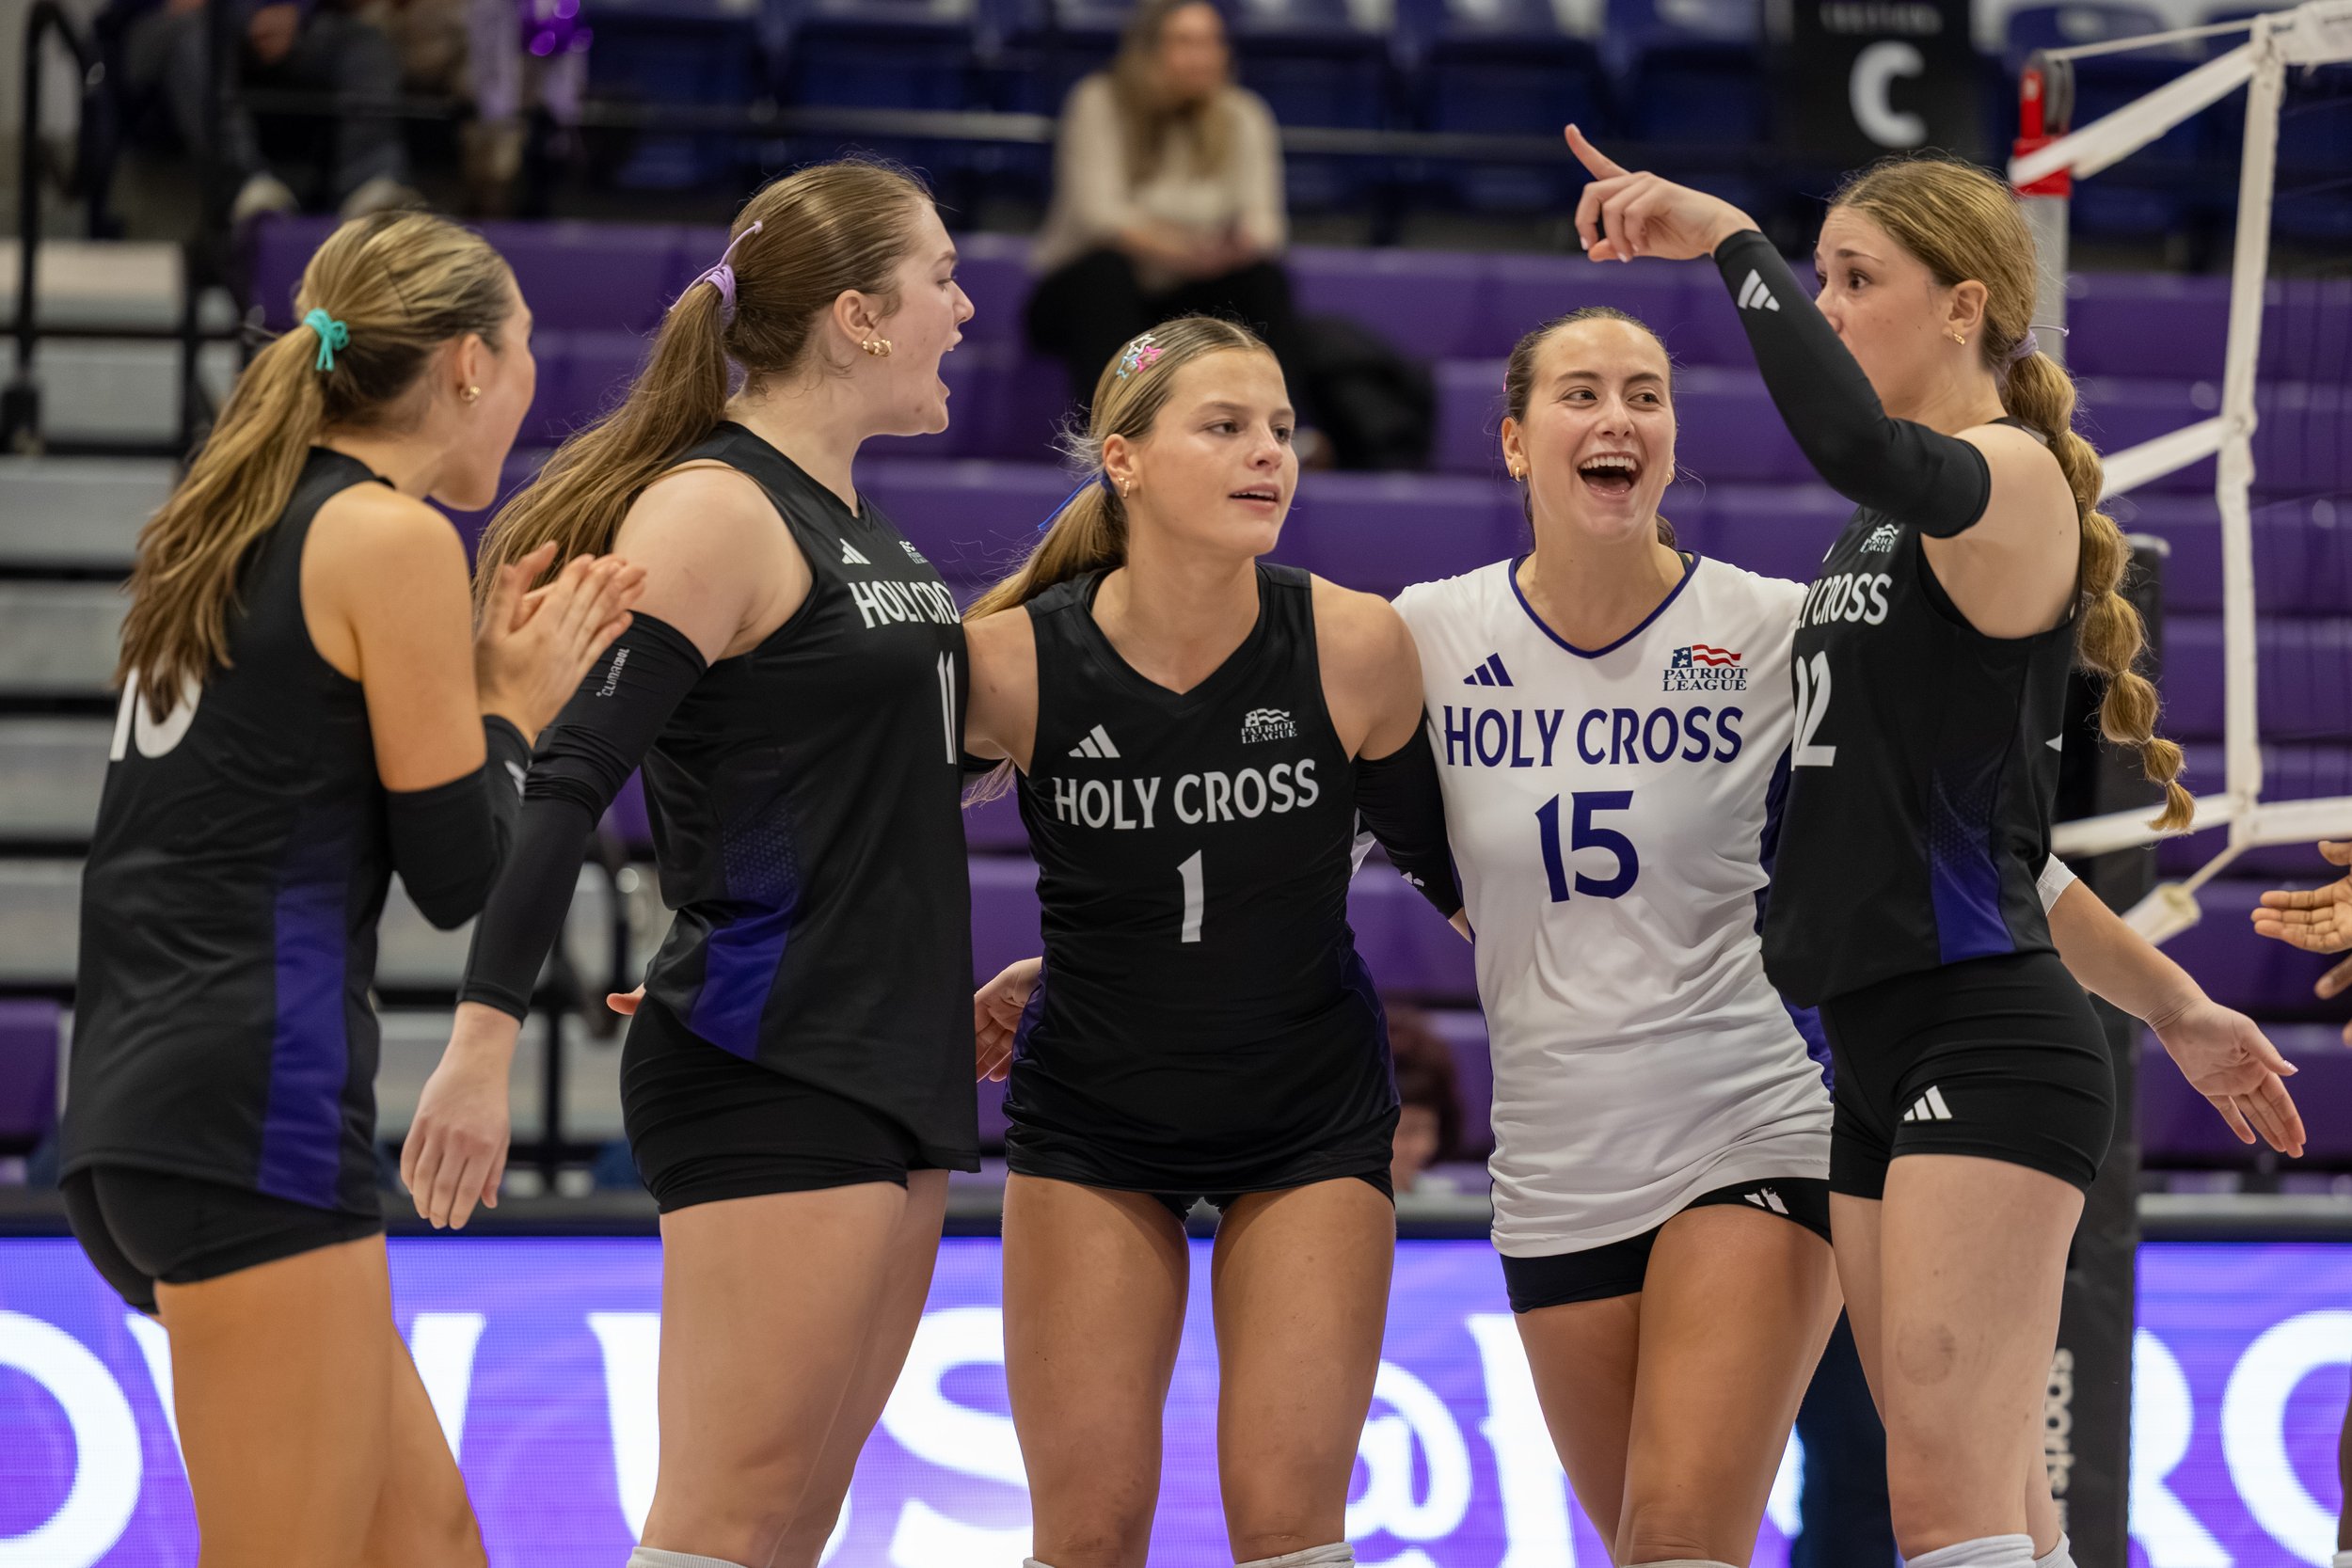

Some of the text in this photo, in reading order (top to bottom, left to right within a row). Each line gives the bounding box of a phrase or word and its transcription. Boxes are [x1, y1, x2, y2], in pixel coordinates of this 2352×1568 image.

[1847, 40, 1927, 149] C
[847, 579, 961, 629] HOLY CRO
[1811, 572, 1893, 626] CROSS
[1661, 667, 1749, 681] PATRIOT
[1661, 679, 1748, 692] LEAGUE
[1241, 721, 1296, 736] PATRIOT
[1242, 729, 1298, 744] LEAGUE
[1442, 705, 1744, 768] HOLY CROSS
[1790, 650, 1837, 772] 12
[1052, 758, 1319, 831] HOLY CROSS
[1534, 790, 1640, 904] 15
[1176, 848, 1205, 943] 1
